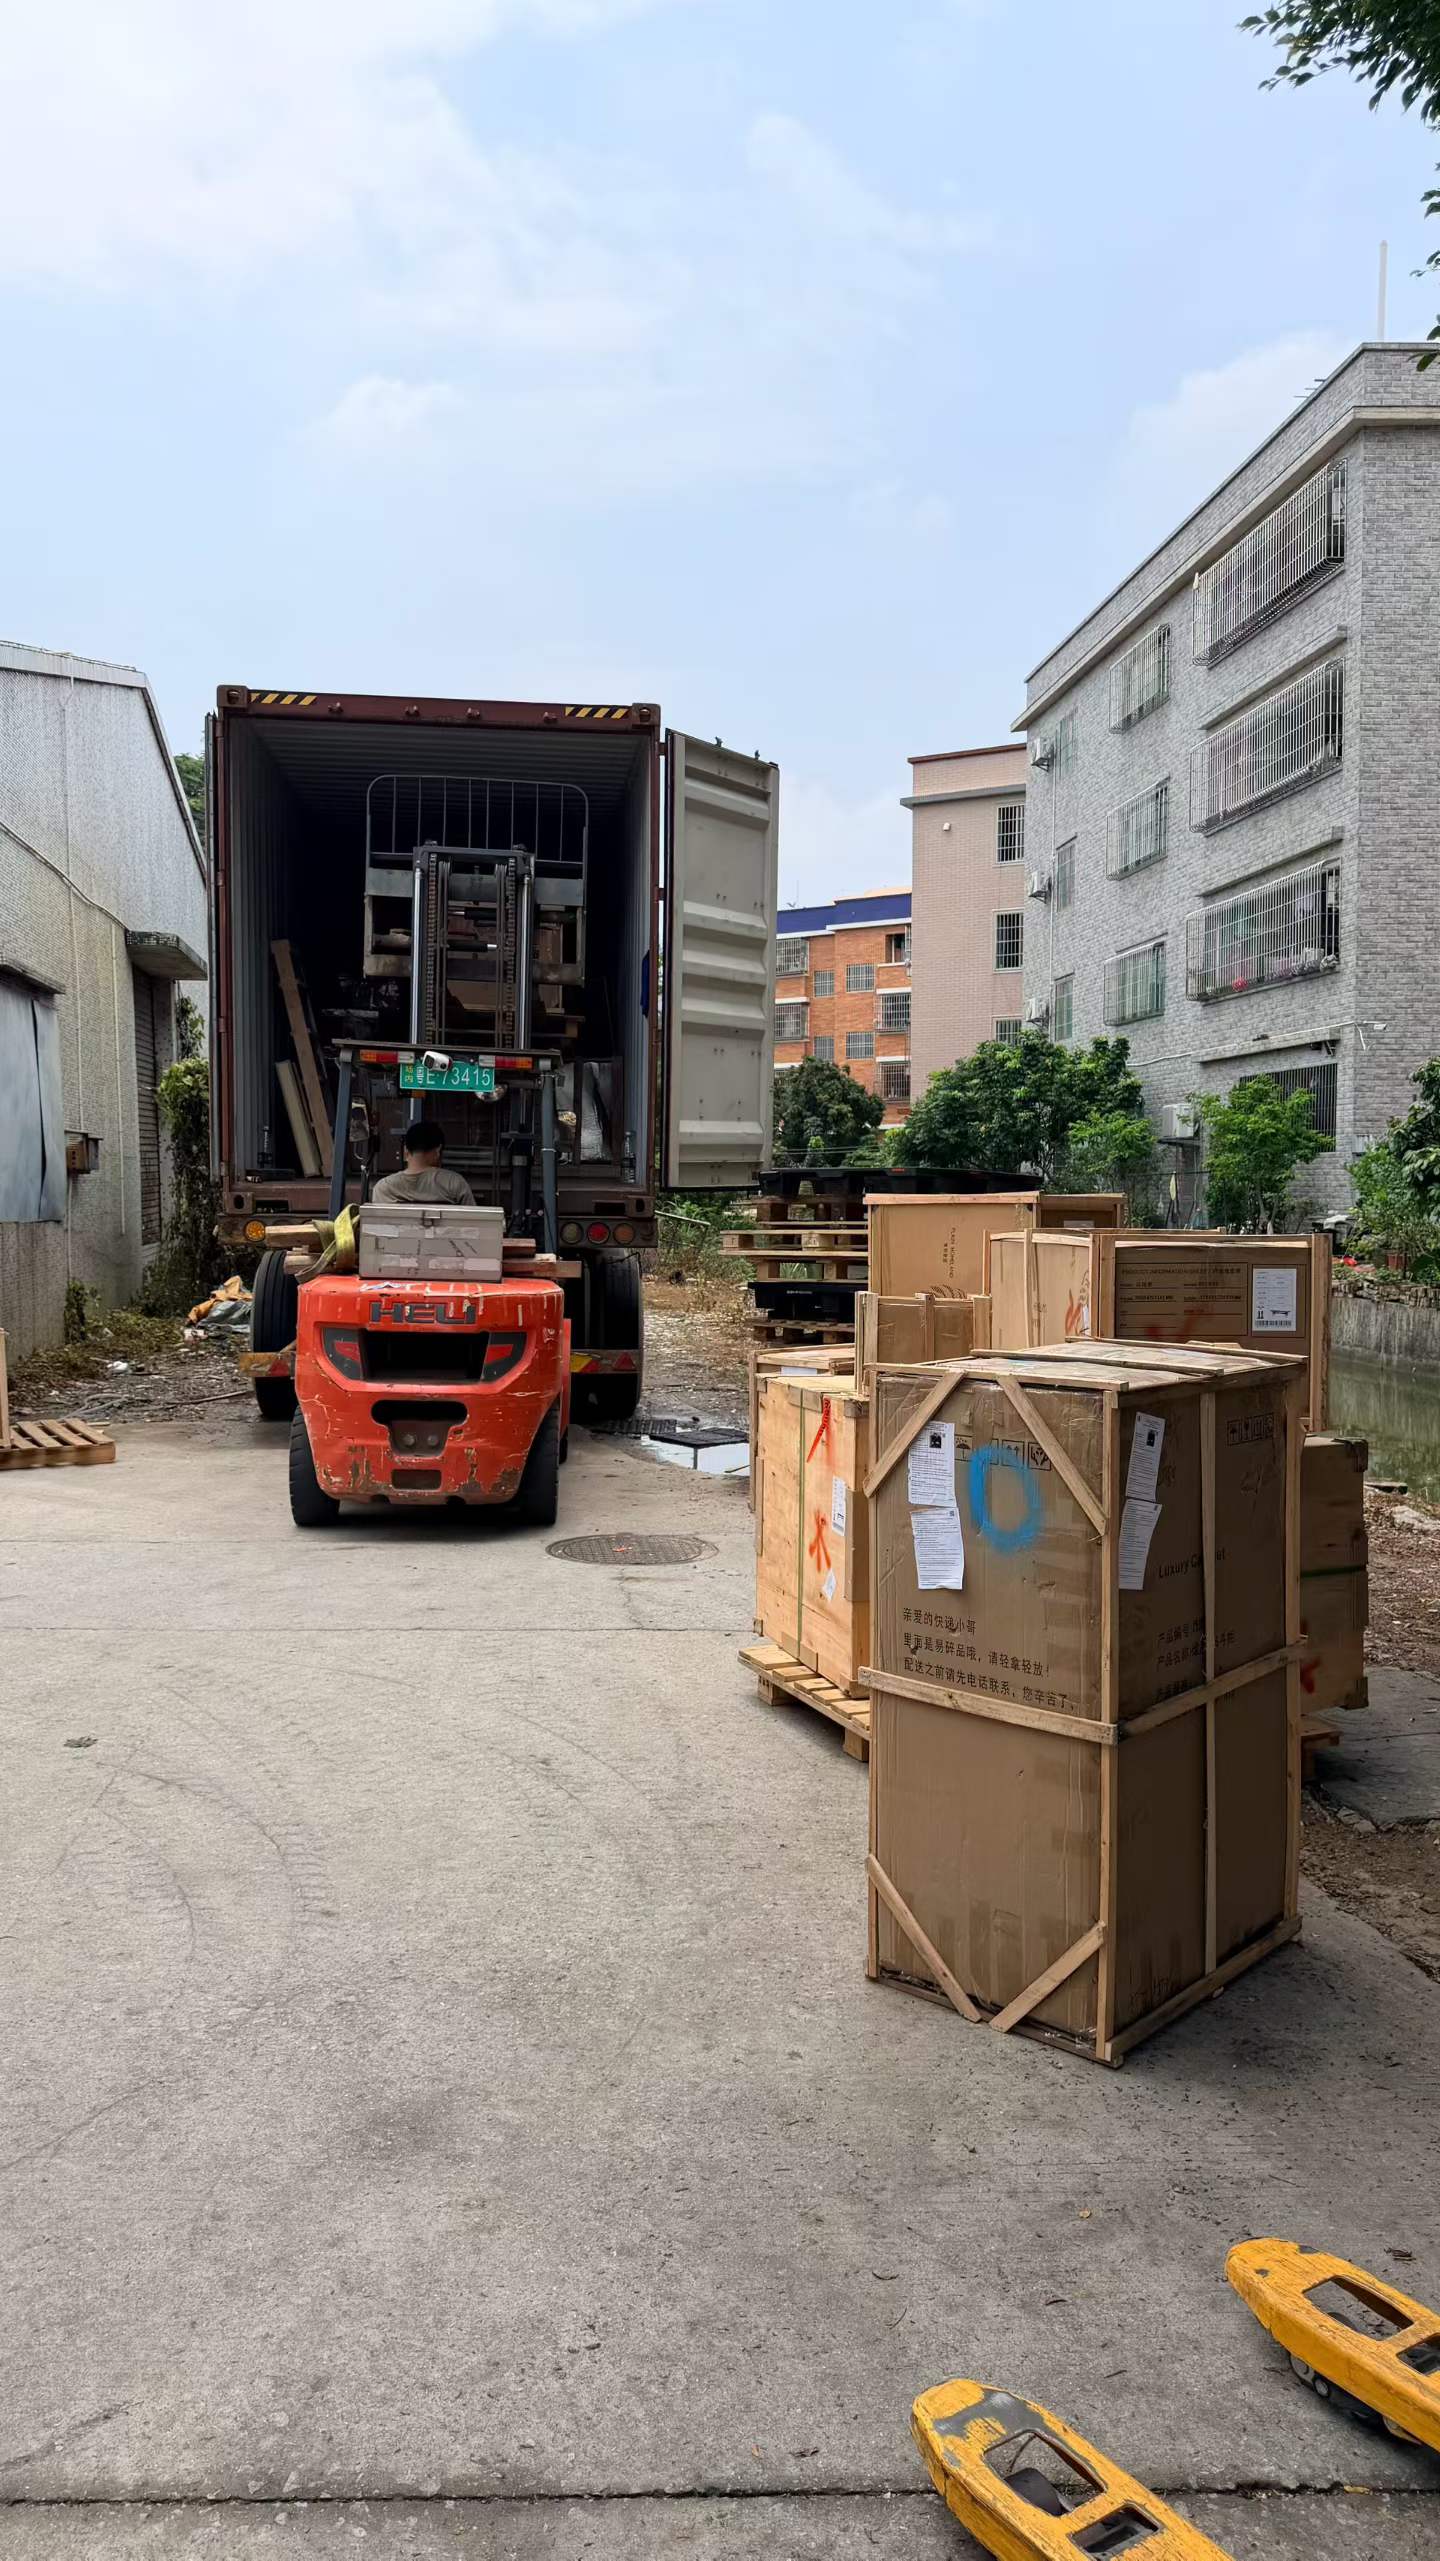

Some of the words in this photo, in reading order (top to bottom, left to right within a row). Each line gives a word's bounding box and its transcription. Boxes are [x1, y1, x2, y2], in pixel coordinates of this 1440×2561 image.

[369, 1301, 477, 1325] HELI
[1157, 1559, 1189, 1579] Luxury
[1190, 1547, 1226, 1568] Caet
[903, 1607, 976, 1635] 亲爱的快递小哥
